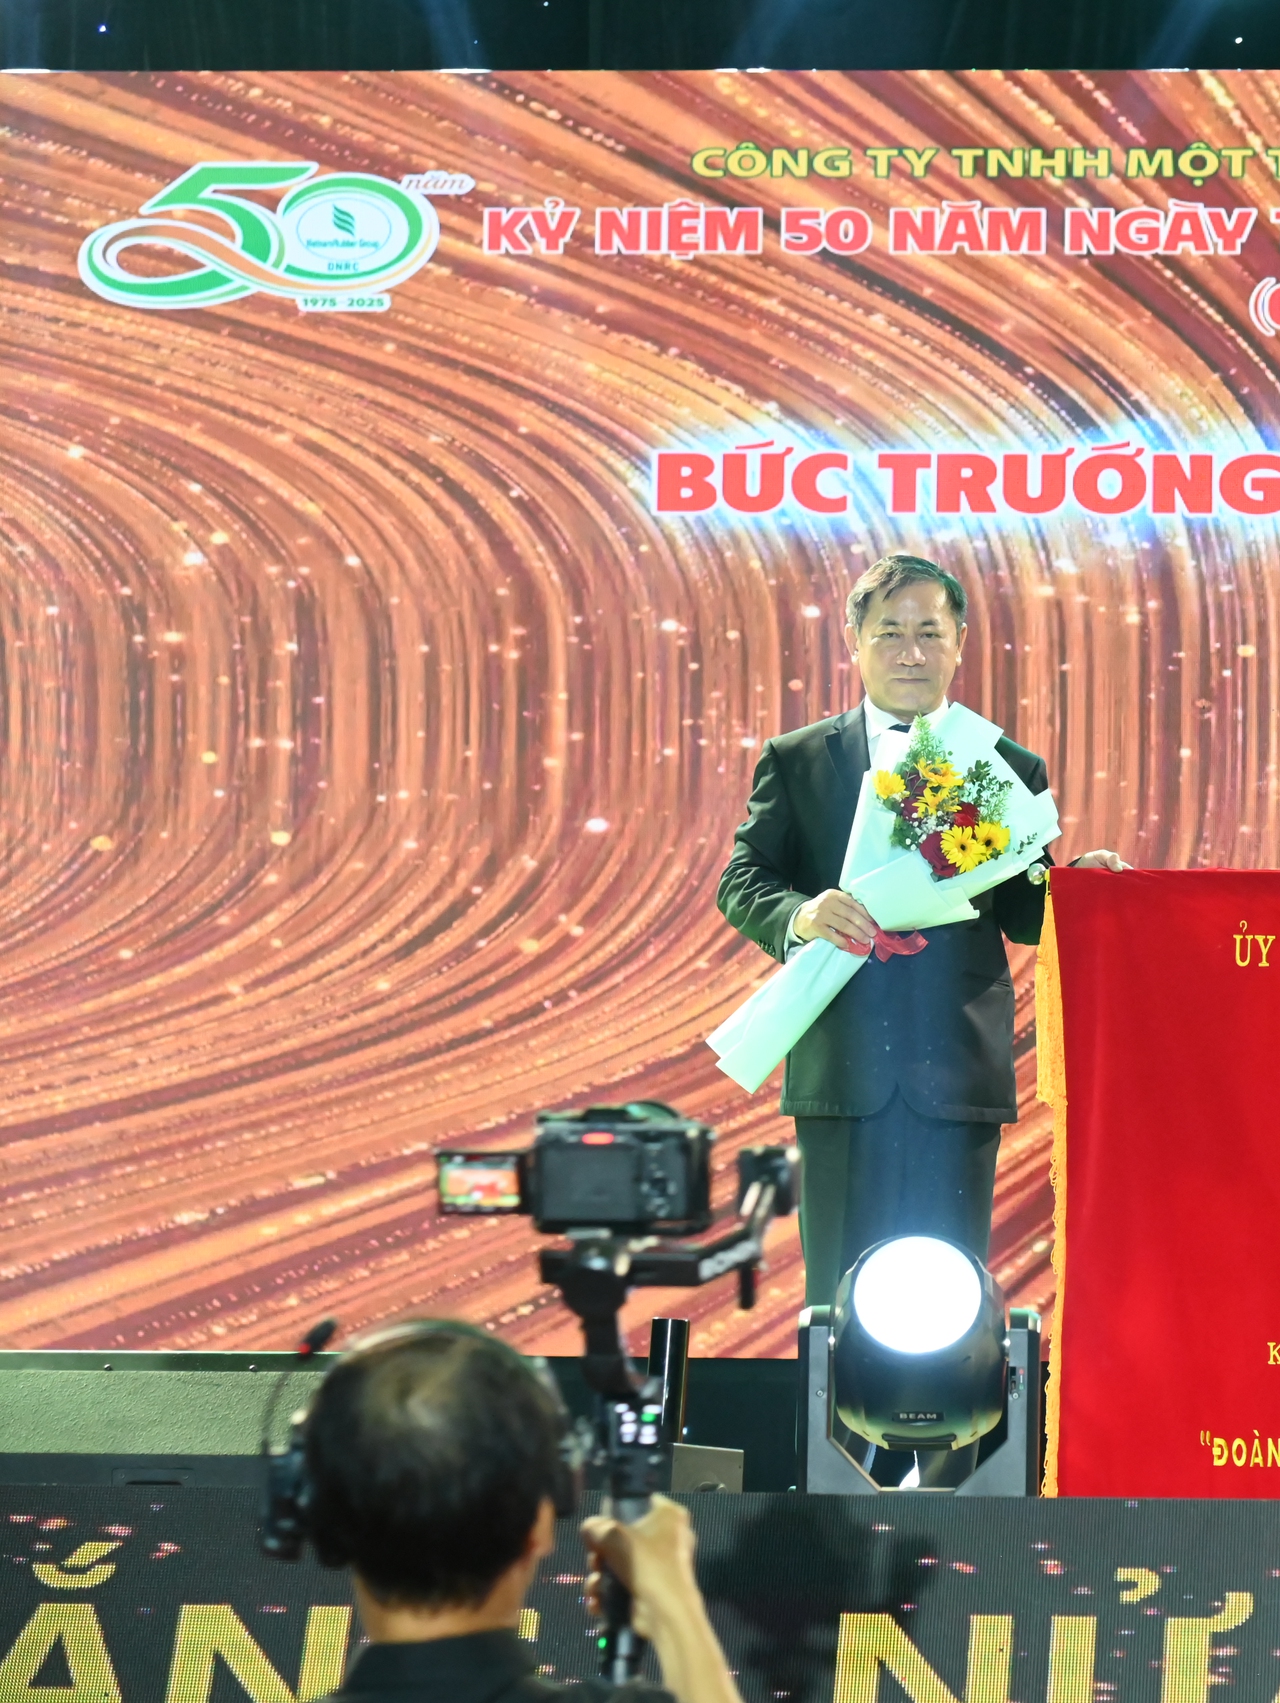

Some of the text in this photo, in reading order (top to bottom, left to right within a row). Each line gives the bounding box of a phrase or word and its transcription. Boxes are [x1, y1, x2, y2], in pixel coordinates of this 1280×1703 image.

[691, 143, 853, 179] CÔNG
[866, 147, 939, 178] TY
[952, 147, 1112, 178] TNHH
[1126, 143, 1253, 186] MỘT
[486, 198, 579, 254] KỶ
[596, 199, 762, 259] NIỆM
[782, 208, 870, 254] 50
[891, 201, 1047, 254] NĂM
[1065, 200, 1257, 254] NGÀY
[653, 439, 850, 514] BỨC
[1232, 919, 1276, 967] ỦY
[899, 1412, 938, 1420] BEAM
